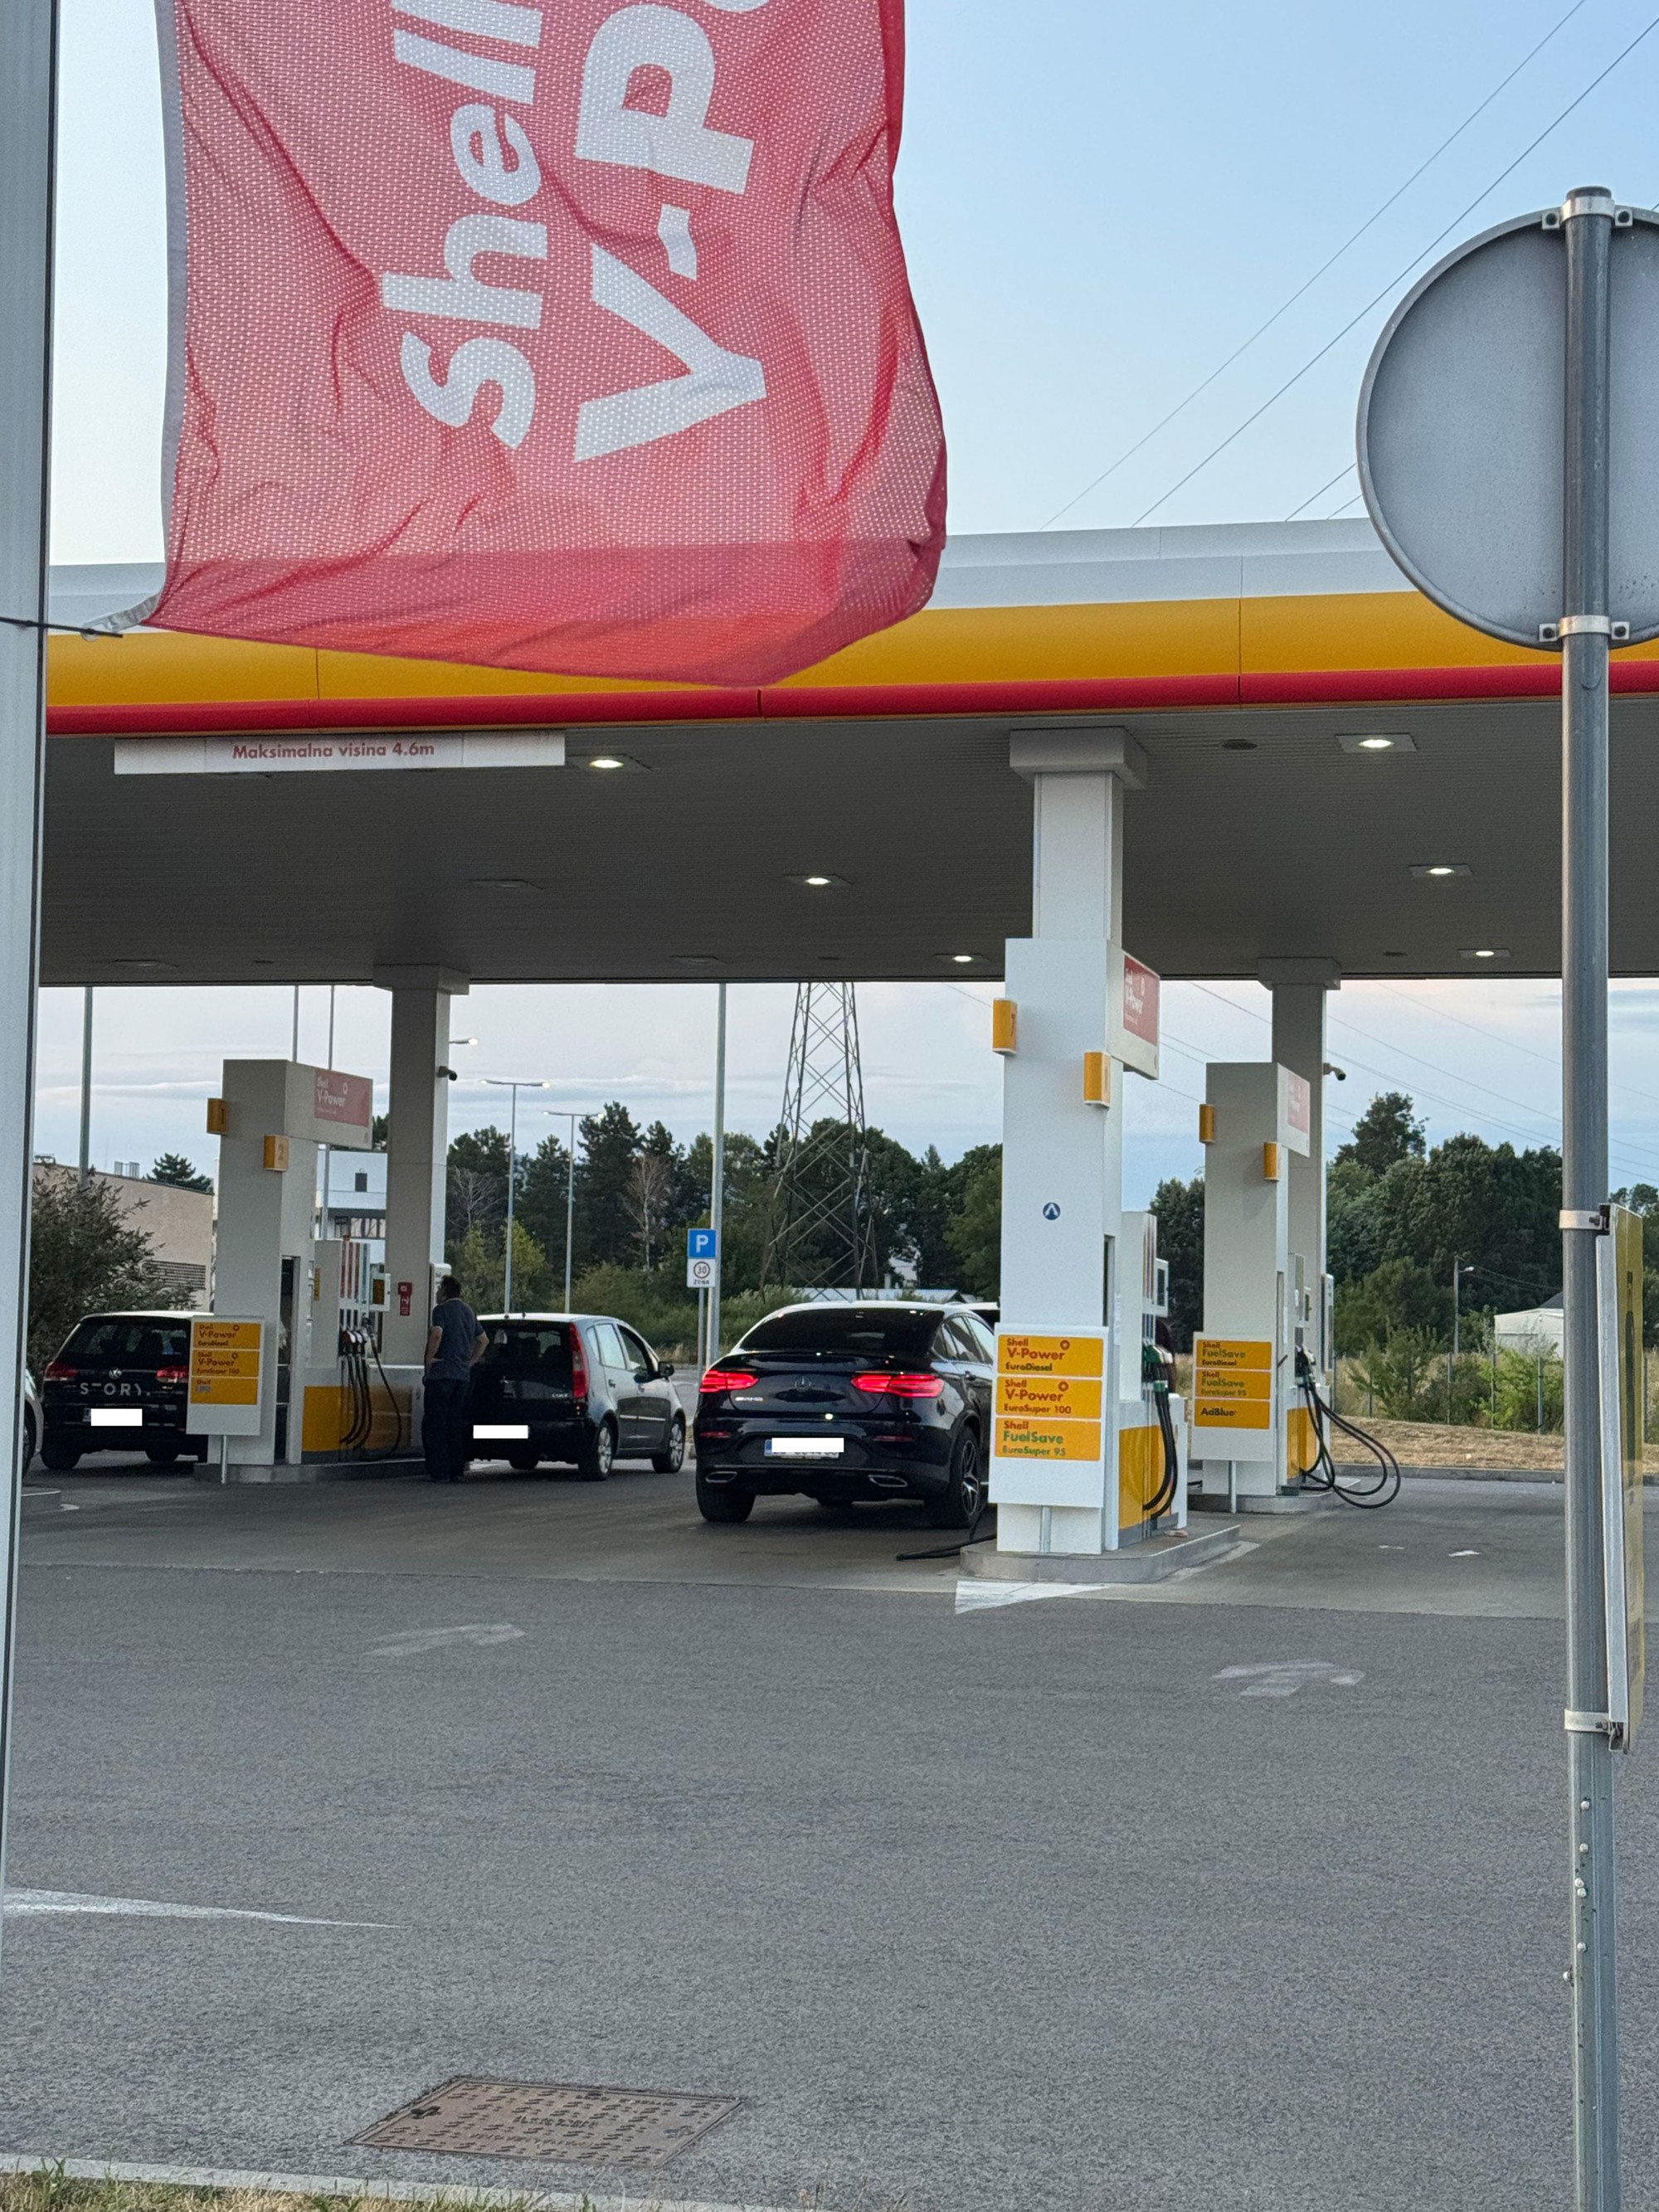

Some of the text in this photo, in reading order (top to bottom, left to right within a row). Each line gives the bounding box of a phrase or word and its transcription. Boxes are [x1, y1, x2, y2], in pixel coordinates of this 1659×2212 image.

[379, 0, 547, 450] Shell
[574, 0, 770, 463] V-P
[232, 741, 435, 759] Maksimalna visina 4.6m
[278, 1143, 285, 1161] 2
[696, 1234, 709, 1253] P
[697, 1266, 708, 1275] 30
[199, 1330, 236, 1339] V-Power
[1006, 1338, 1029, 1347] Shell
[1006, 1347, 1066, 1361] V-Power
[1202, 1349, 1246, 1359] FuelSave
[197, 1359, 235, 1367] V-Power
[1005, 1362, 1053, 1372] EuroDiesel
[1005, 1379, 1028, 1388] Shell
[1201, 1378, 1245, 1388] FuelSave
[1005, 1388, 1064, 1402] V-Power
[1004, 1403, 1072, 1415] EuroSuper 100
[1200, 1407, 1236, 1417] AdBlue
[1004, 1421, 1029, 1430] Shell
[1003, 1431, 1064, 1444] FuelSave
[1002, 1446, 1067, 1456] EuroSuper 95
